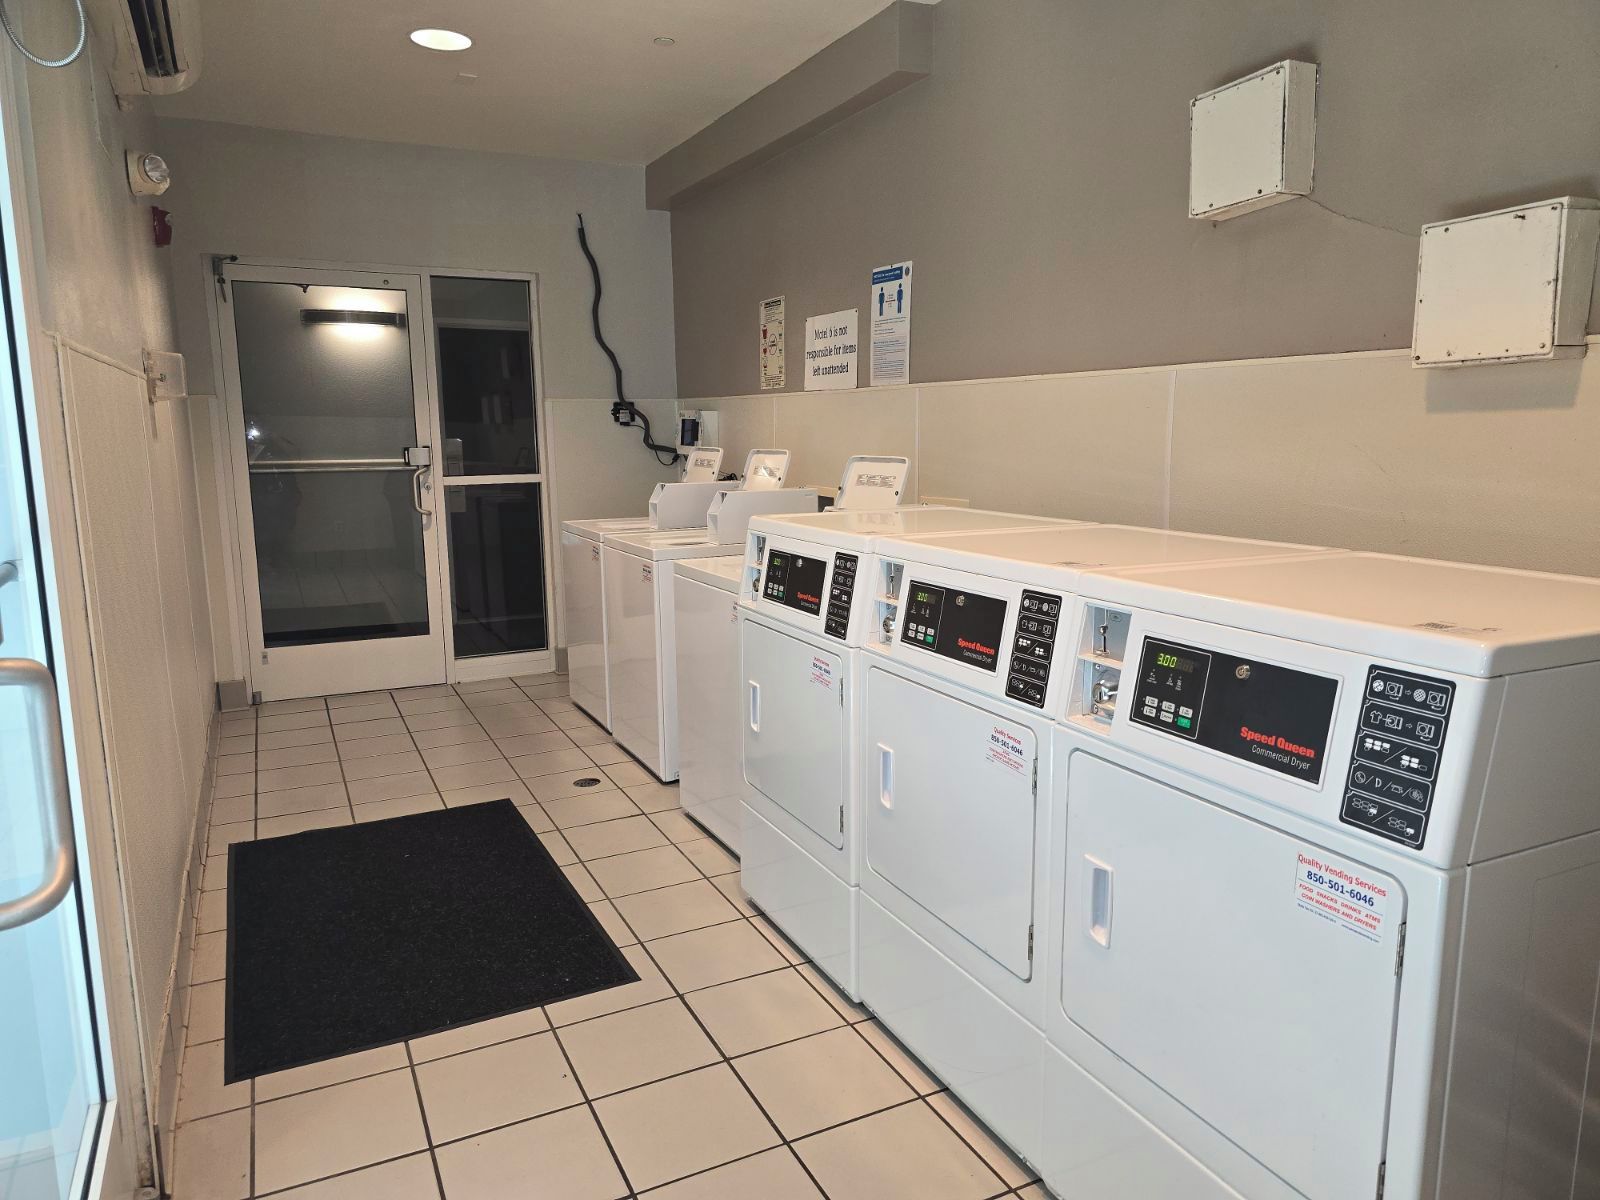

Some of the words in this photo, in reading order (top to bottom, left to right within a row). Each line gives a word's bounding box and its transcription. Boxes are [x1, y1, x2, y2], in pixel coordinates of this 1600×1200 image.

[814, 328, 828, 340] Motel
[834, 326, 838, 337] is
[839, 325, 848, 337] not
[806, 346, 833, 361] responsible
[842, 343, 857, 355] items
[812, 365, 821, 376] left
[821, 362, 849, 376] unattended
[957, 637, 975, 650] Speed
[975, 642, 995, 656] Queen
[1240, 726, 1276, 746] Speed
[1277, 737, 1315, 758] Queen
[1251, 744, 1290, 764] Commercial
[1291, 756, 1311, 770] Dryer
[1298, 854, 1323, 871] Quality
[1324, 864, 1353, 884] Vending
[1355, 877, 1387, 897] Services
[1306, 870, 1375, 907] 850-501-6046
[1299, 883, 1314, 893] FOOD
[1316, 891, 1338, 905] SNACKS
[1340, 902, 1362, 915] DRINKS
[1364, 912, 1381, 924] ATMS
[1301, 892, 1315, 903] COIN
[1315, 898, 1341, 914] WASHERS
[1341, 910, 1353, 920] AND
[1354, 916, 1377, 930] DRYERS
